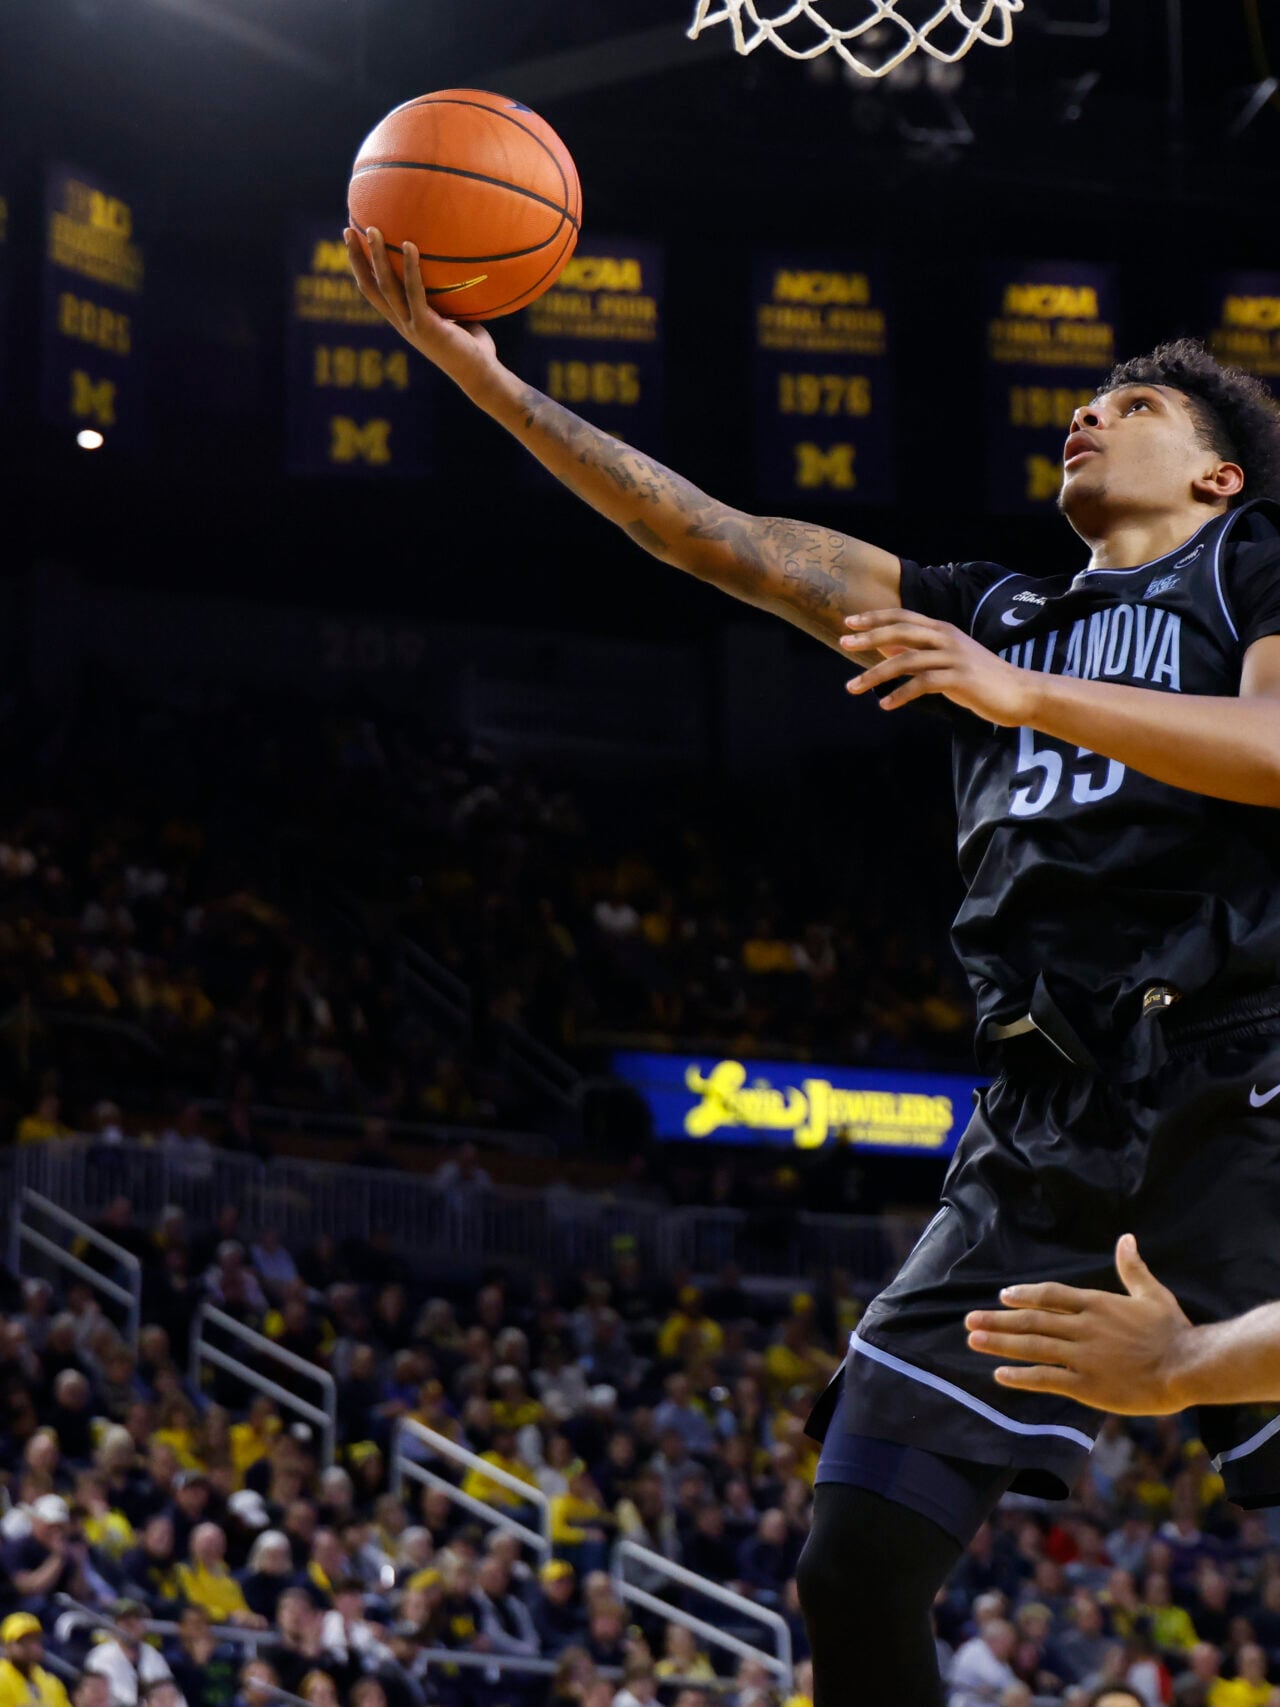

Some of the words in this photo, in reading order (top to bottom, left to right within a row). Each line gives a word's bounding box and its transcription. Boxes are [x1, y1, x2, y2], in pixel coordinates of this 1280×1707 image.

[314, 346, 409, 391] 1964
[779, 372, 871, 417] 1976
[330, 416, 393, 466] M
[793, 441, 859, 492] M
